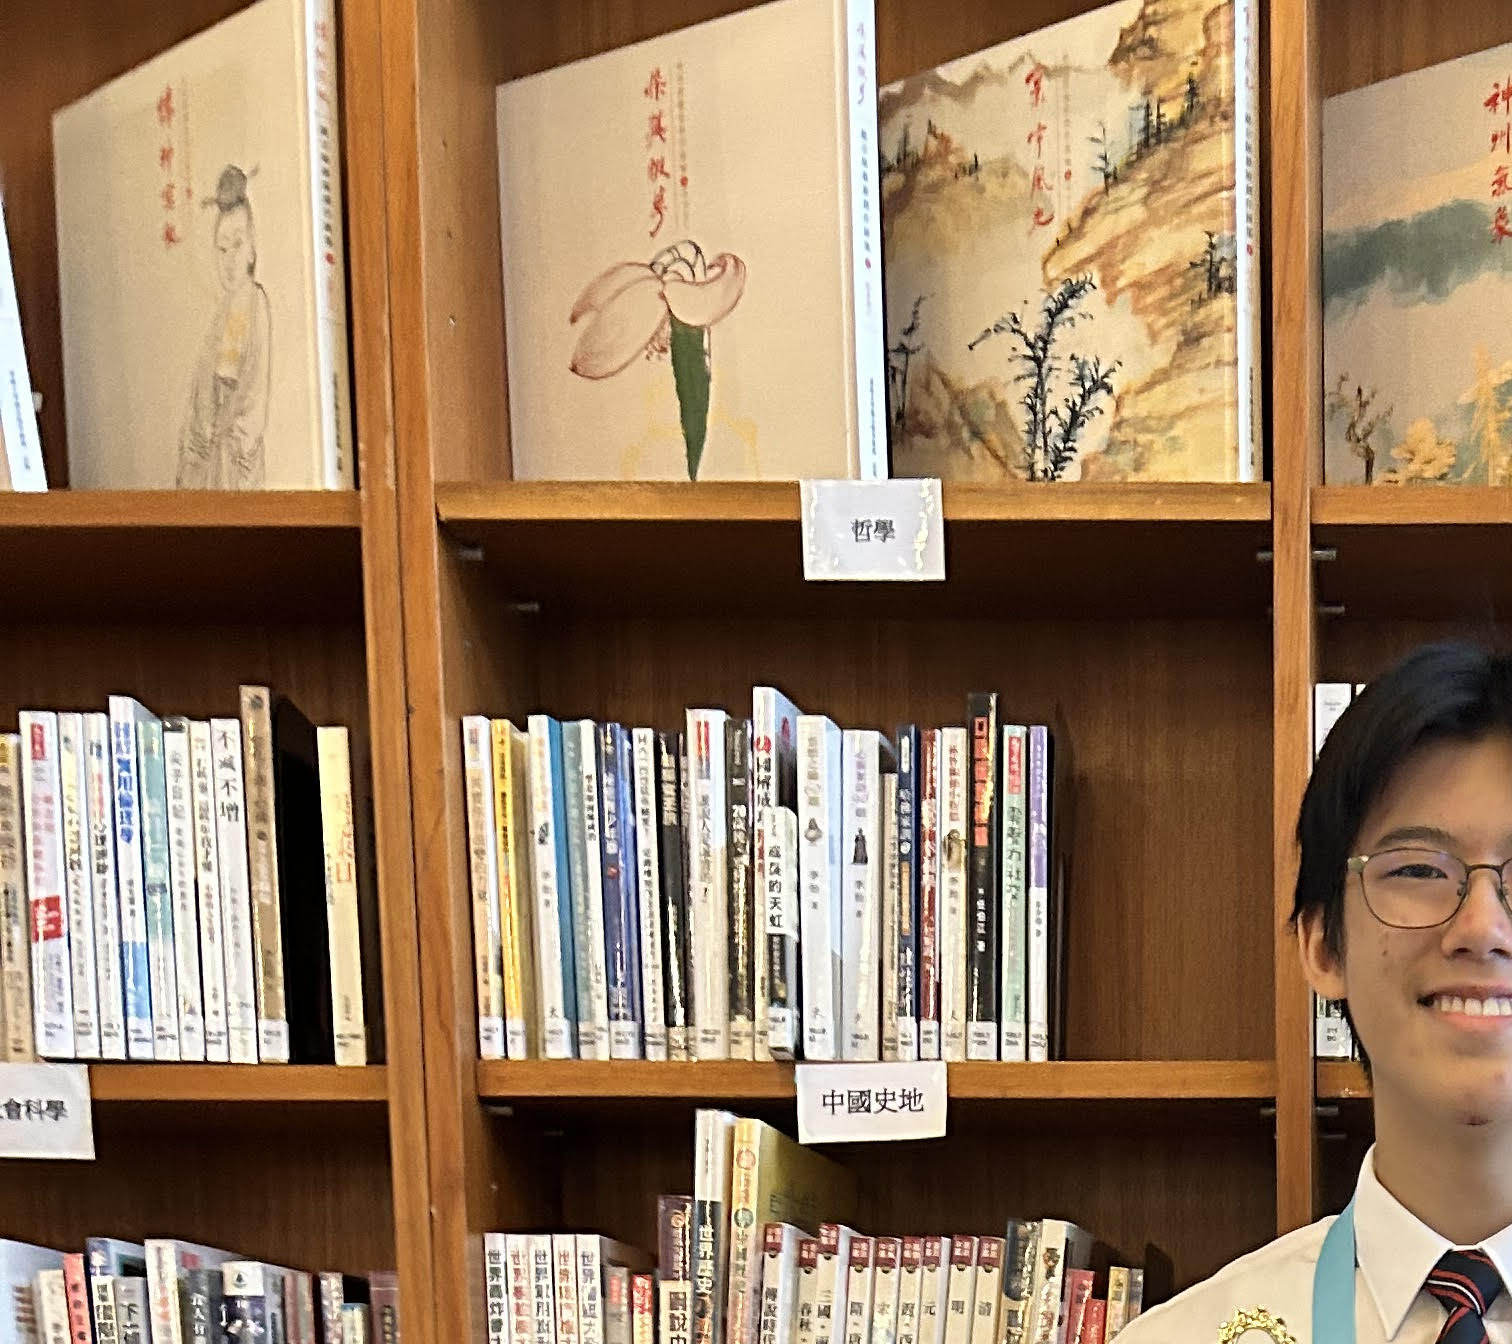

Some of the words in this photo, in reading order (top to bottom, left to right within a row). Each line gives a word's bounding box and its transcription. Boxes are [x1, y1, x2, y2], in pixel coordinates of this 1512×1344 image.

[852, 518, 895, 543] 哲學
[822, 1086, 924, 1115] 中國史地
